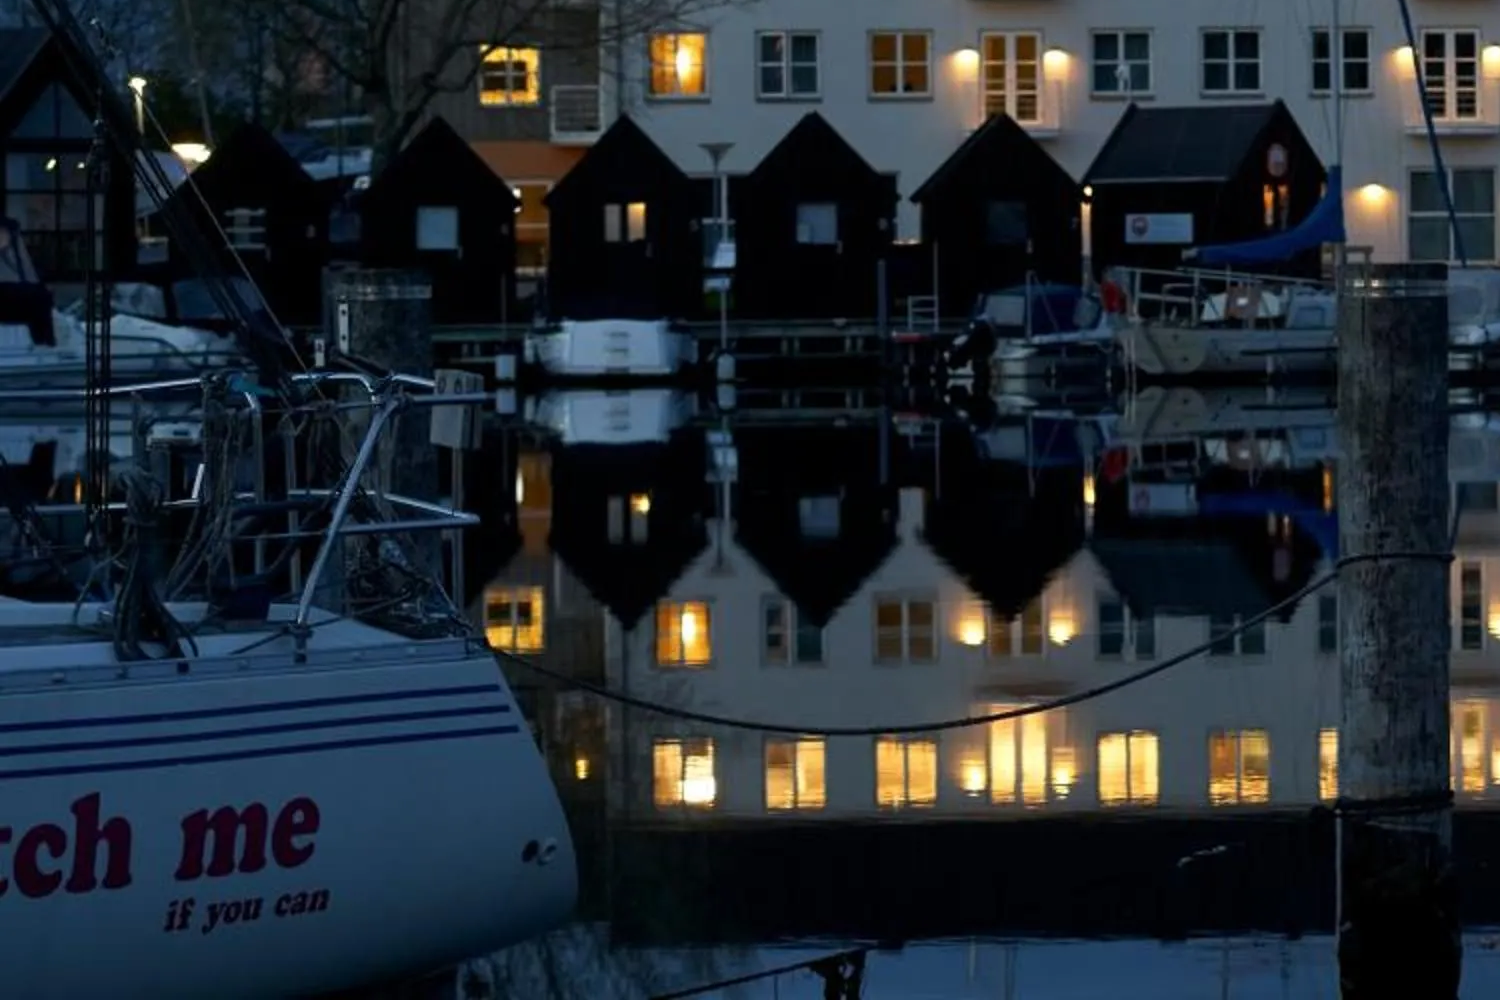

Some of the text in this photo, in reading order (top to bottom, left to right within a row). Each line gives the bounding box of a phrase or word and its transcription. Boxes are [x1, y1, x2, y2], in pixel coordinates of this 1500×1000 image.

[175, 797, 320, 881] me
[164, 889, 330, 935] if you can
